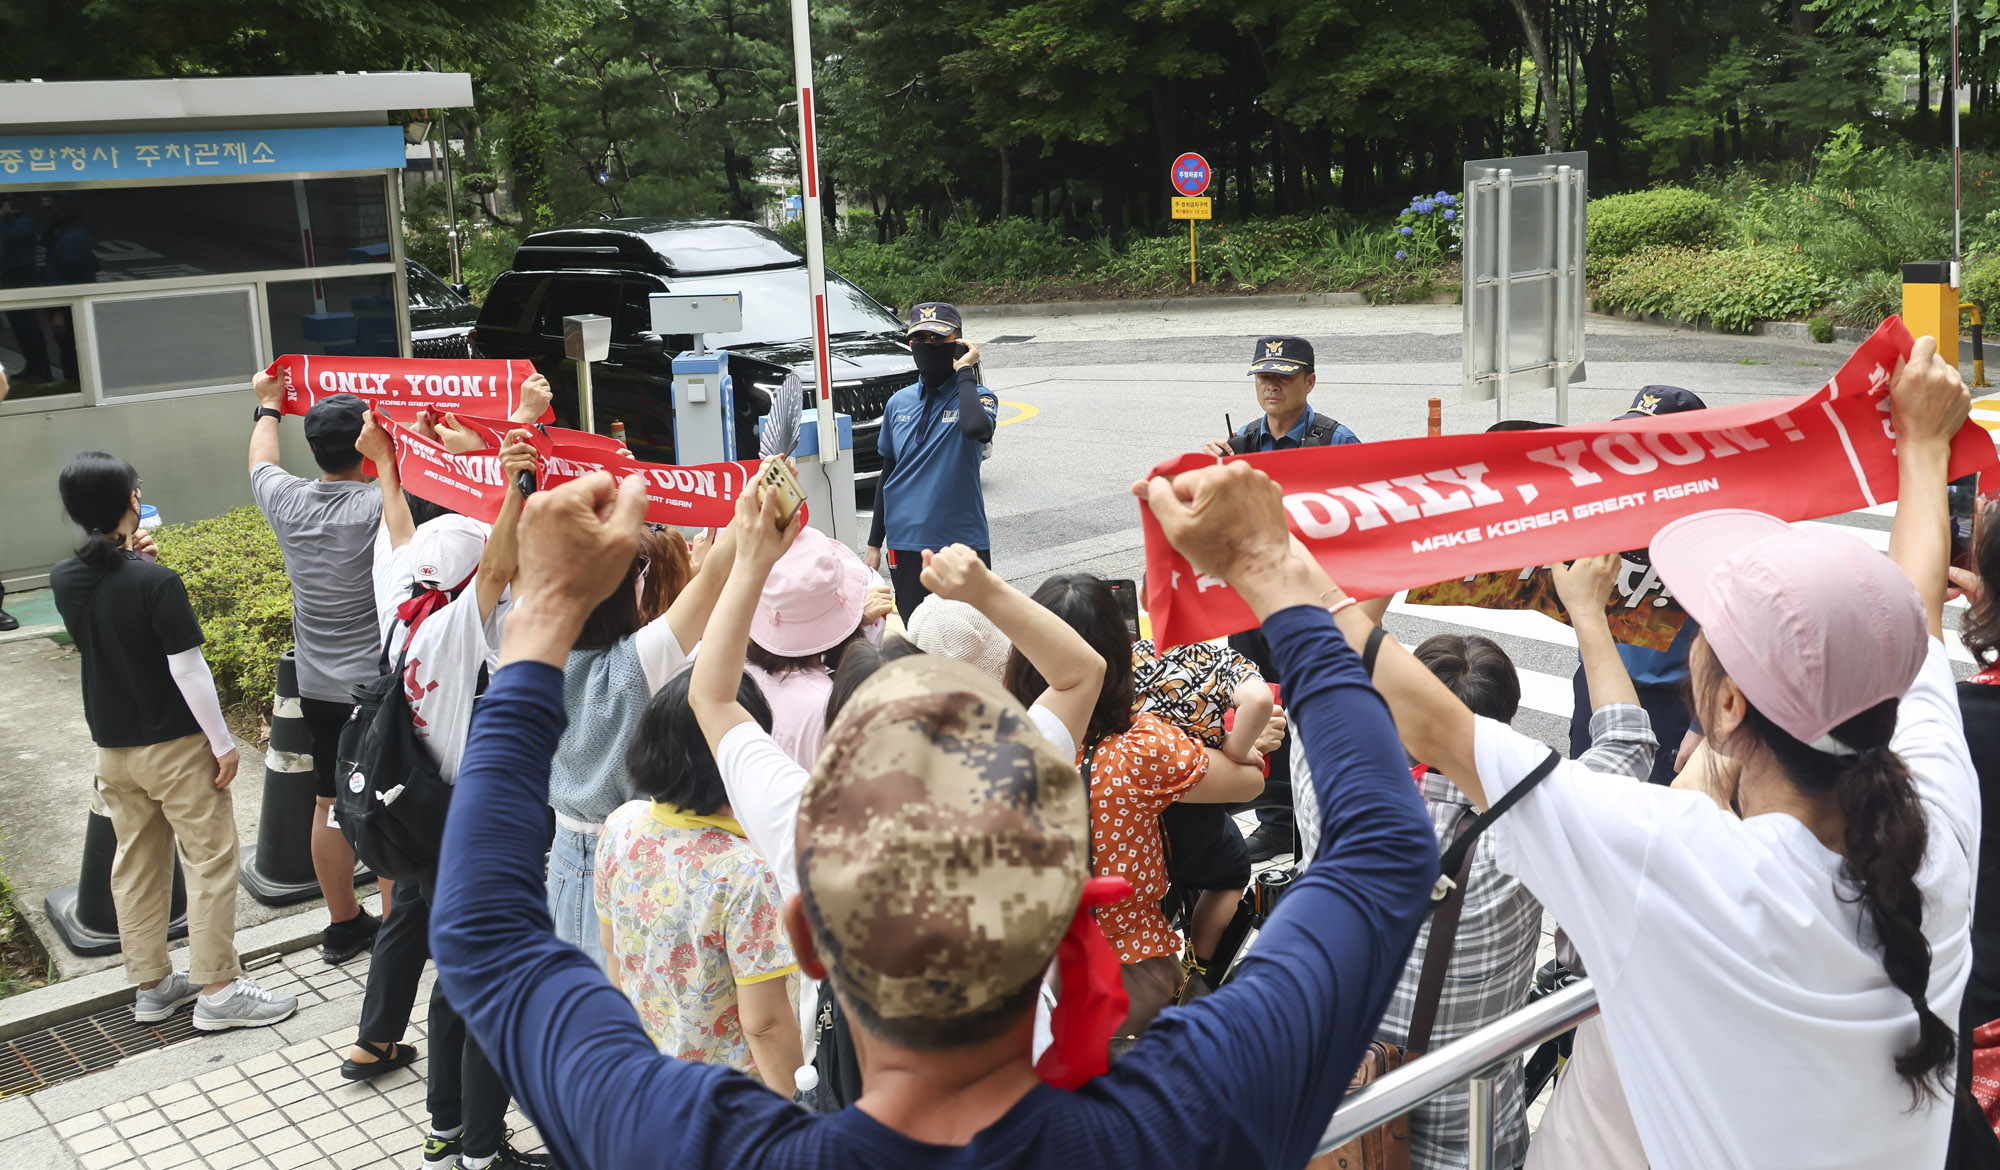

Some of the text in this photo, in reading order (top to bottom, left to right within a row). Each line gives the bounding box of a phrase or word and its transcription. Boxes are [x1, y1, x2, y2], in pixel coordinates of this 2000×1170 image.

[0, 142, 275, 174] 종합청사 주차관제소
[284, 366, 297, 402] YOON
[665, 498, 692, 508] AGAIN
[1411, 477, 1720, 554] MAKE KOREA GREAT AGAIN
